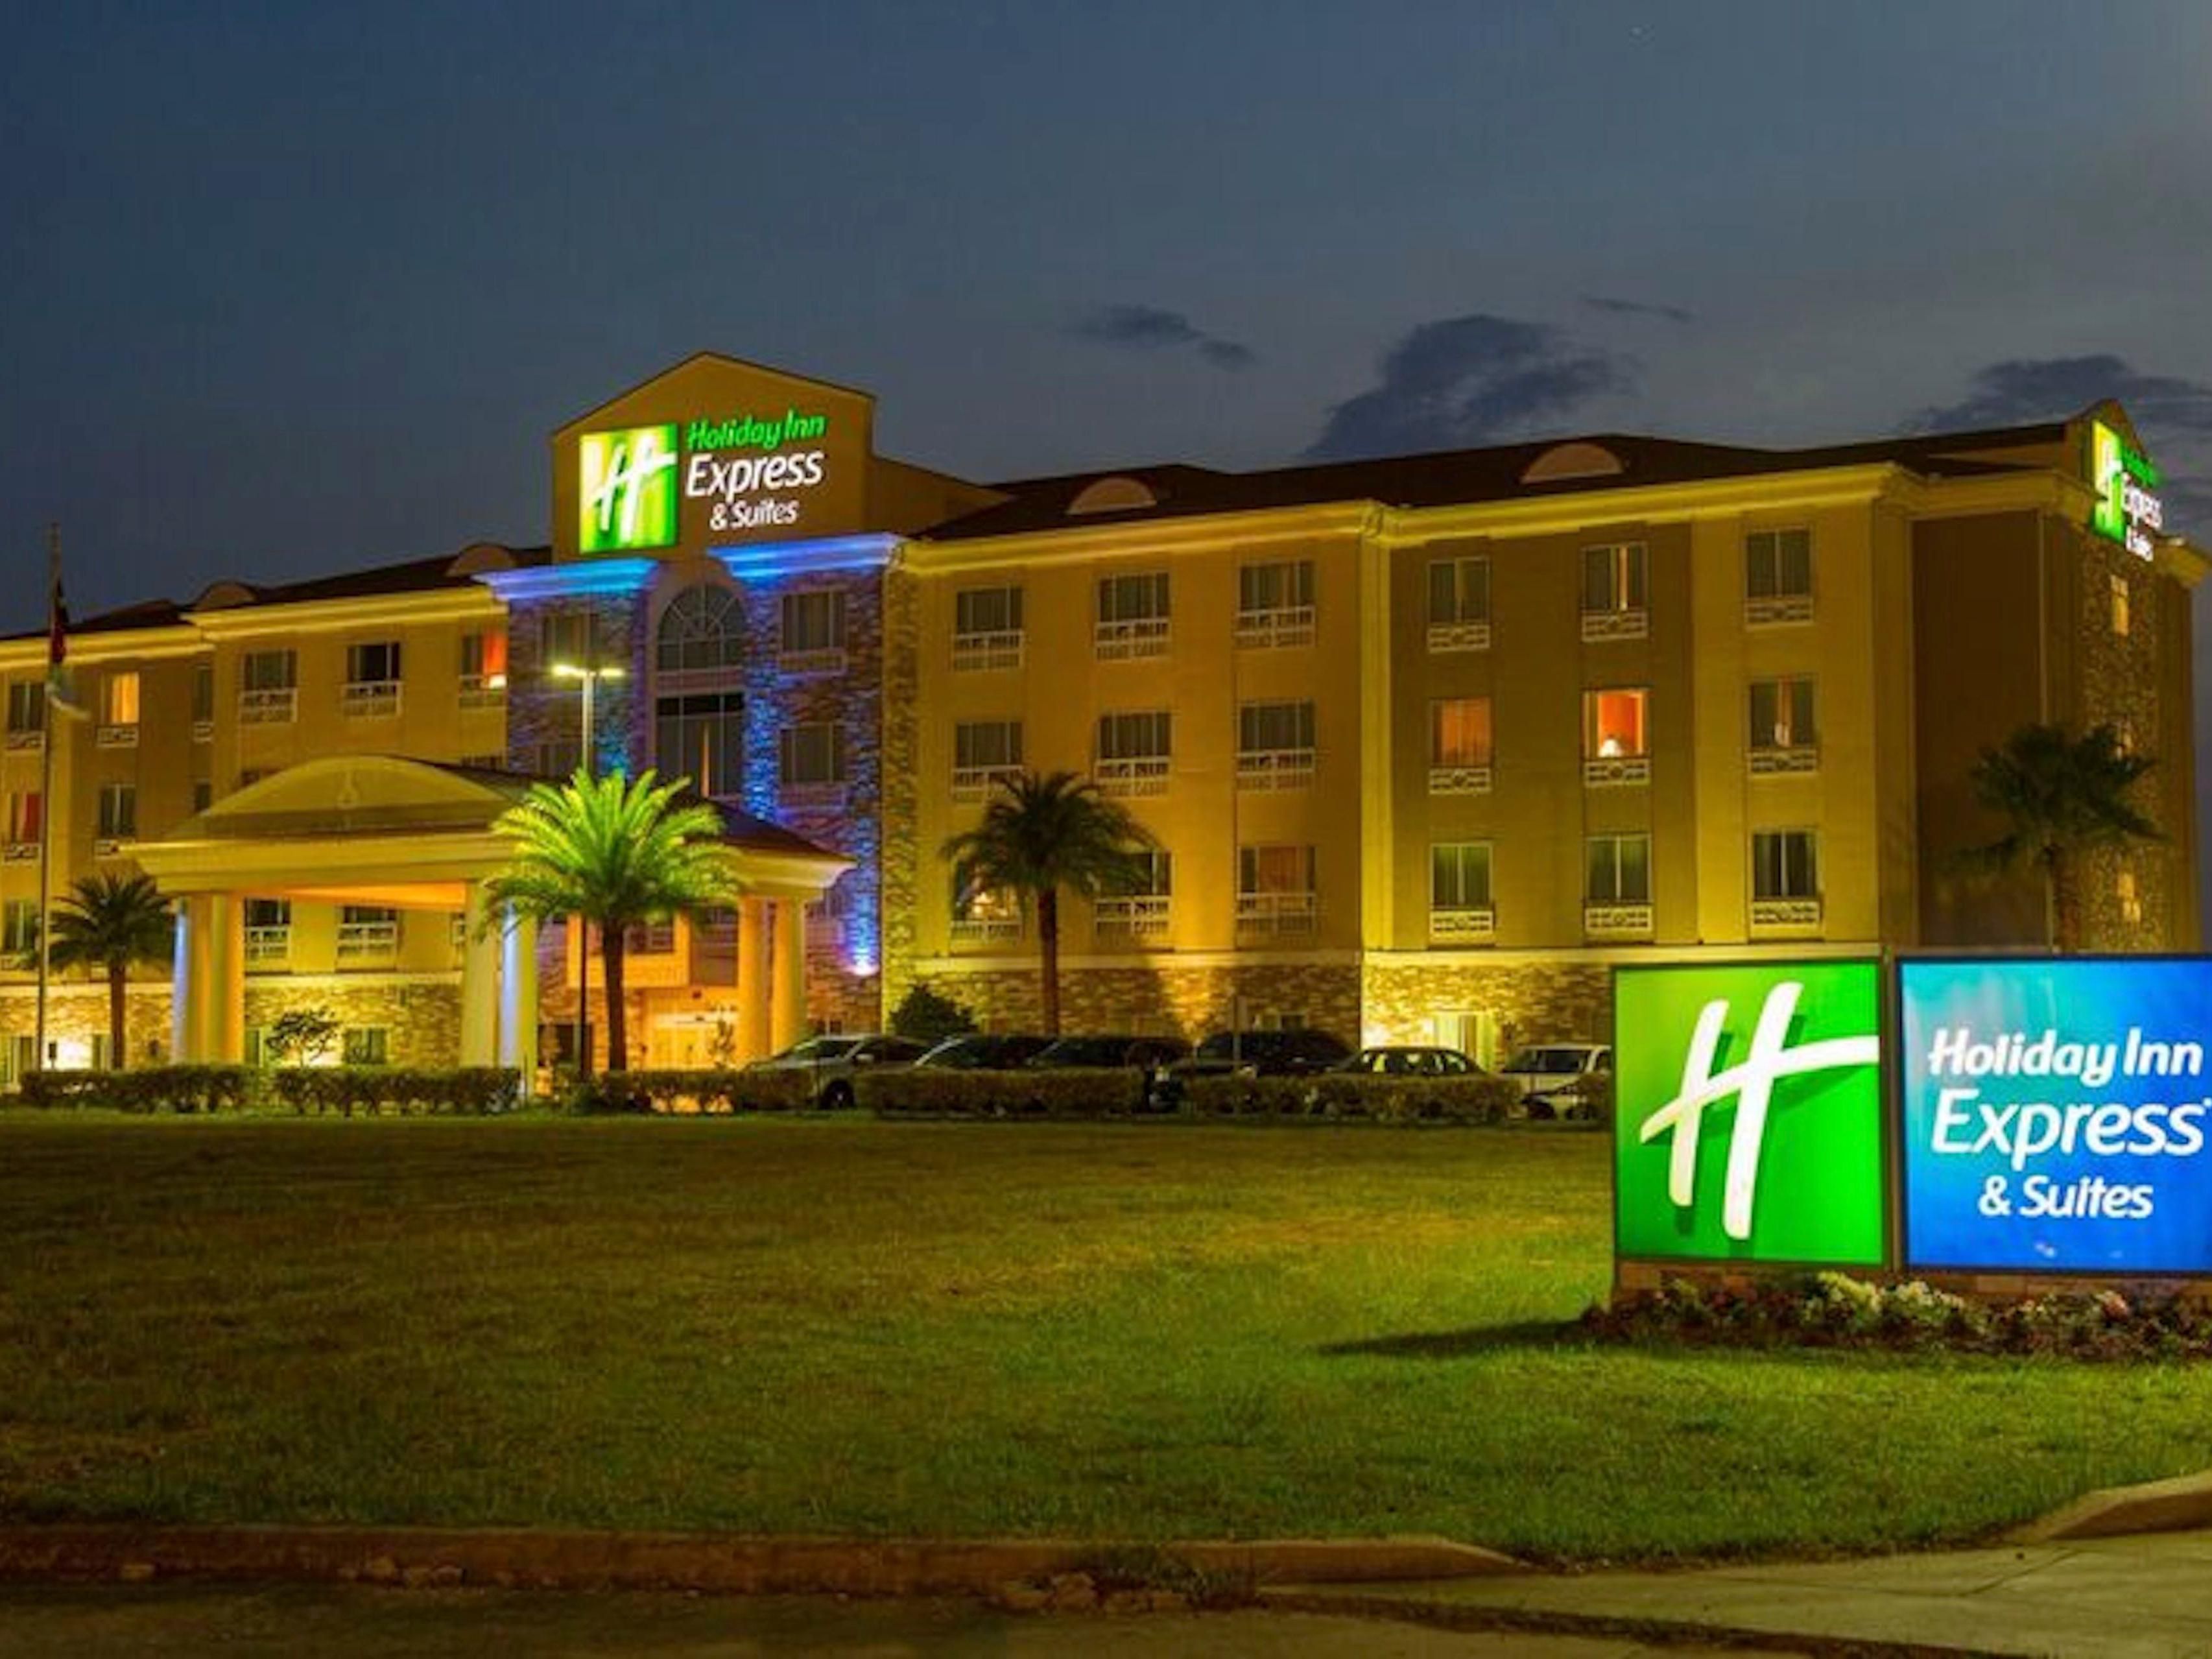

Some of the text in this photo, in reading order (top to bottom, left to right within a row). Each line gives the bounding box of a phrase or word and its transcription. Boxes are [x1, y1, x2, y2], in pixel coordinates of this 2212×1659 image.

[687, 409, 826, 449] Holiday Inn
[686, 450, 825, 502] Express
[709, 499, 798, 531] & Suites
[1929, 1027, 2202, 1087] Holiday Inn
[1932, 1088, 2206, 1171] Express
[1979, 1176, 2154, 1219] & Suites
